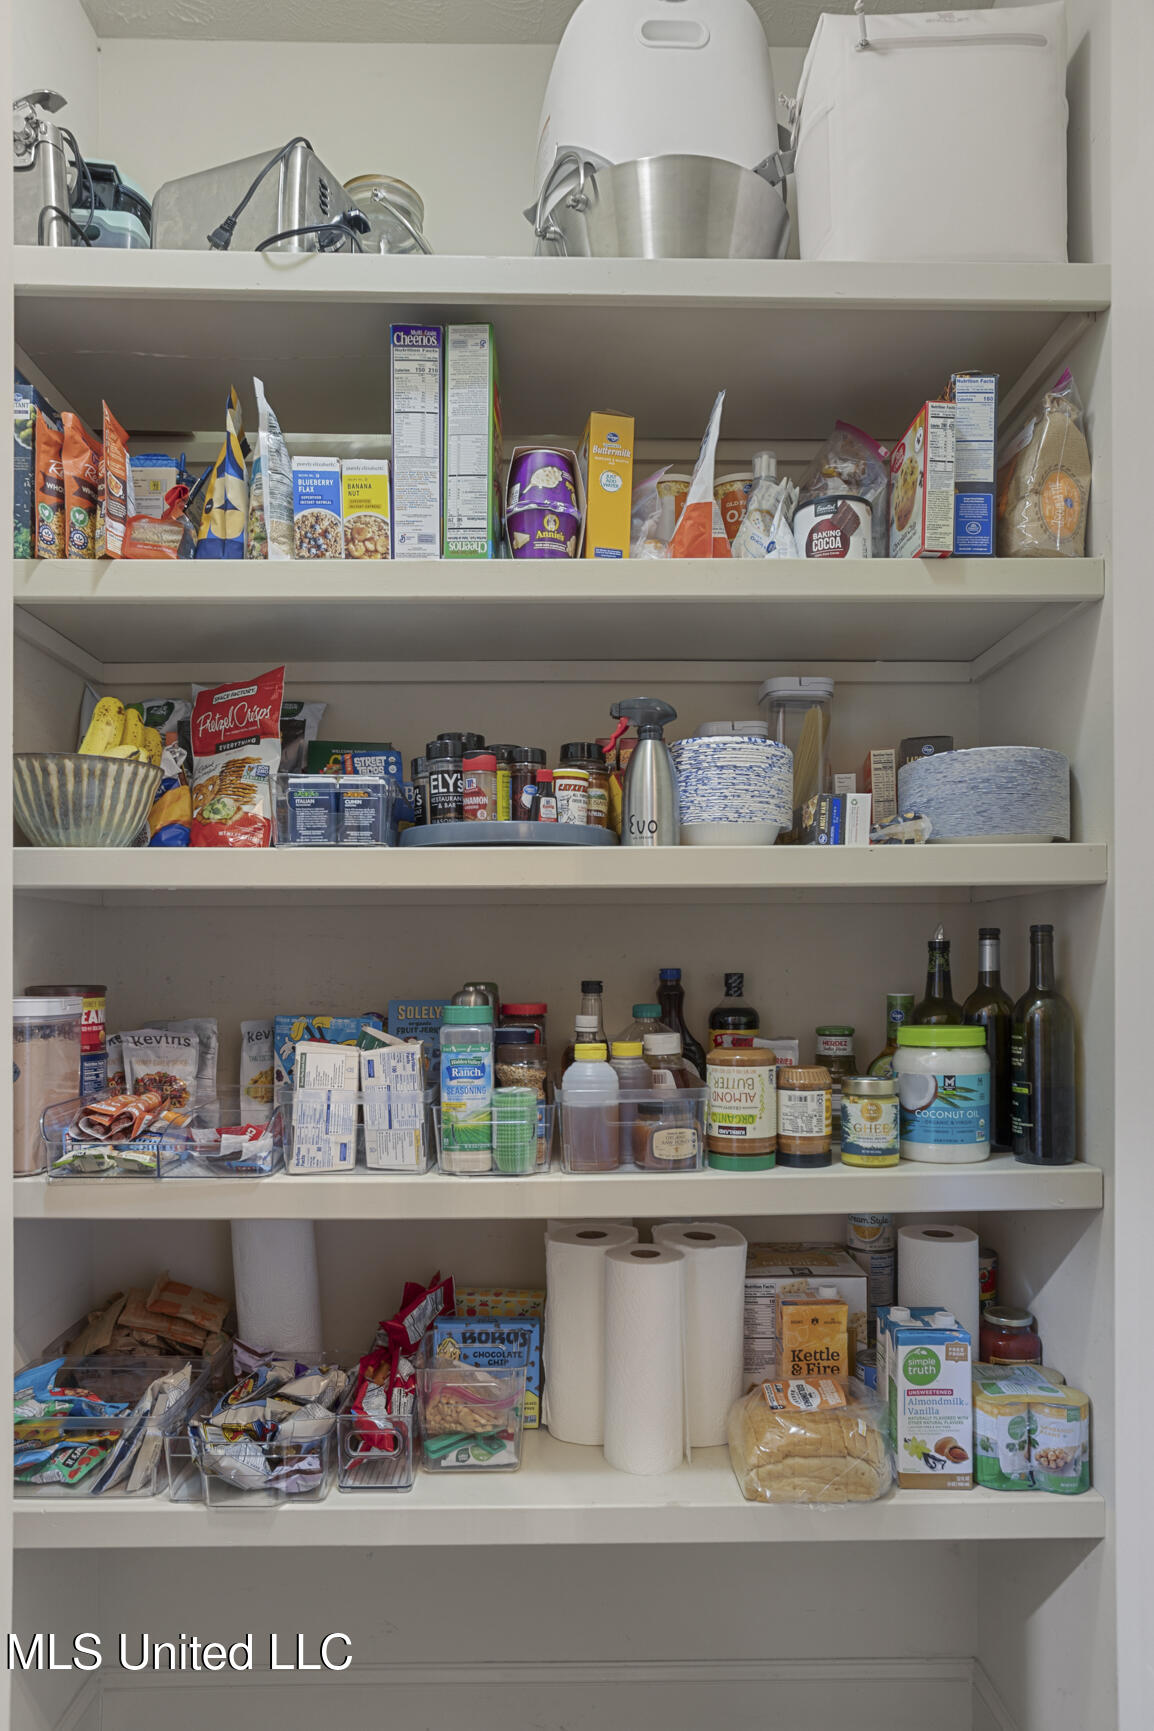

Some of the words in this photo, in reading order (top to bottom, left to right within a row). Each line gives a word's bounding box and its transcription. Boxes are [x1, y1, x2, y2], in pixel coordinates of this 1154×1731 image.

[394, 332, 438, 346] Cheerios
[593, 445, 632, 457] Buttermilk
[535, 531, 565, 541] Annie's
[812, 530, 841, 540] BAKING
[448, 541, 487, 553] Cheerios
[812, 537, 841, 551] COCOA
[197, 706, 235, 740] Pretzel
[234, 702, 272, 728] Crisps
[219, 738, 257, 751] EVERYTHING
[354, 756, 386, 767] STREET
[398, 1006, 442, 1020] SOLELY
[131, 1034, 191, 1047] kevins
[452, 1067, 482, 1077] Ranch
[714, 1077, 755, 1090] BUTTER
[447, 1086, 486, 1095] SEASONING
[713, 1091, 757, 1104] ALMOND
[915, 1110, 964, 1119] COCONUT
[966, 1110, 980, 1118] OIL
[853, 1123, 890, 1133] GHEE
[791, 1347, 840, 1362] Kettle
[908, 1358, 936, 1367] simple
[791, 1364, 802, 1376] &
[806, 1363, 840, 1376] Fire
[908, 1365, 936, 1375] truth
[908, 1397, 964, 1406] Almondmilk
[908, 1407, 940, 1415] Vanilla
